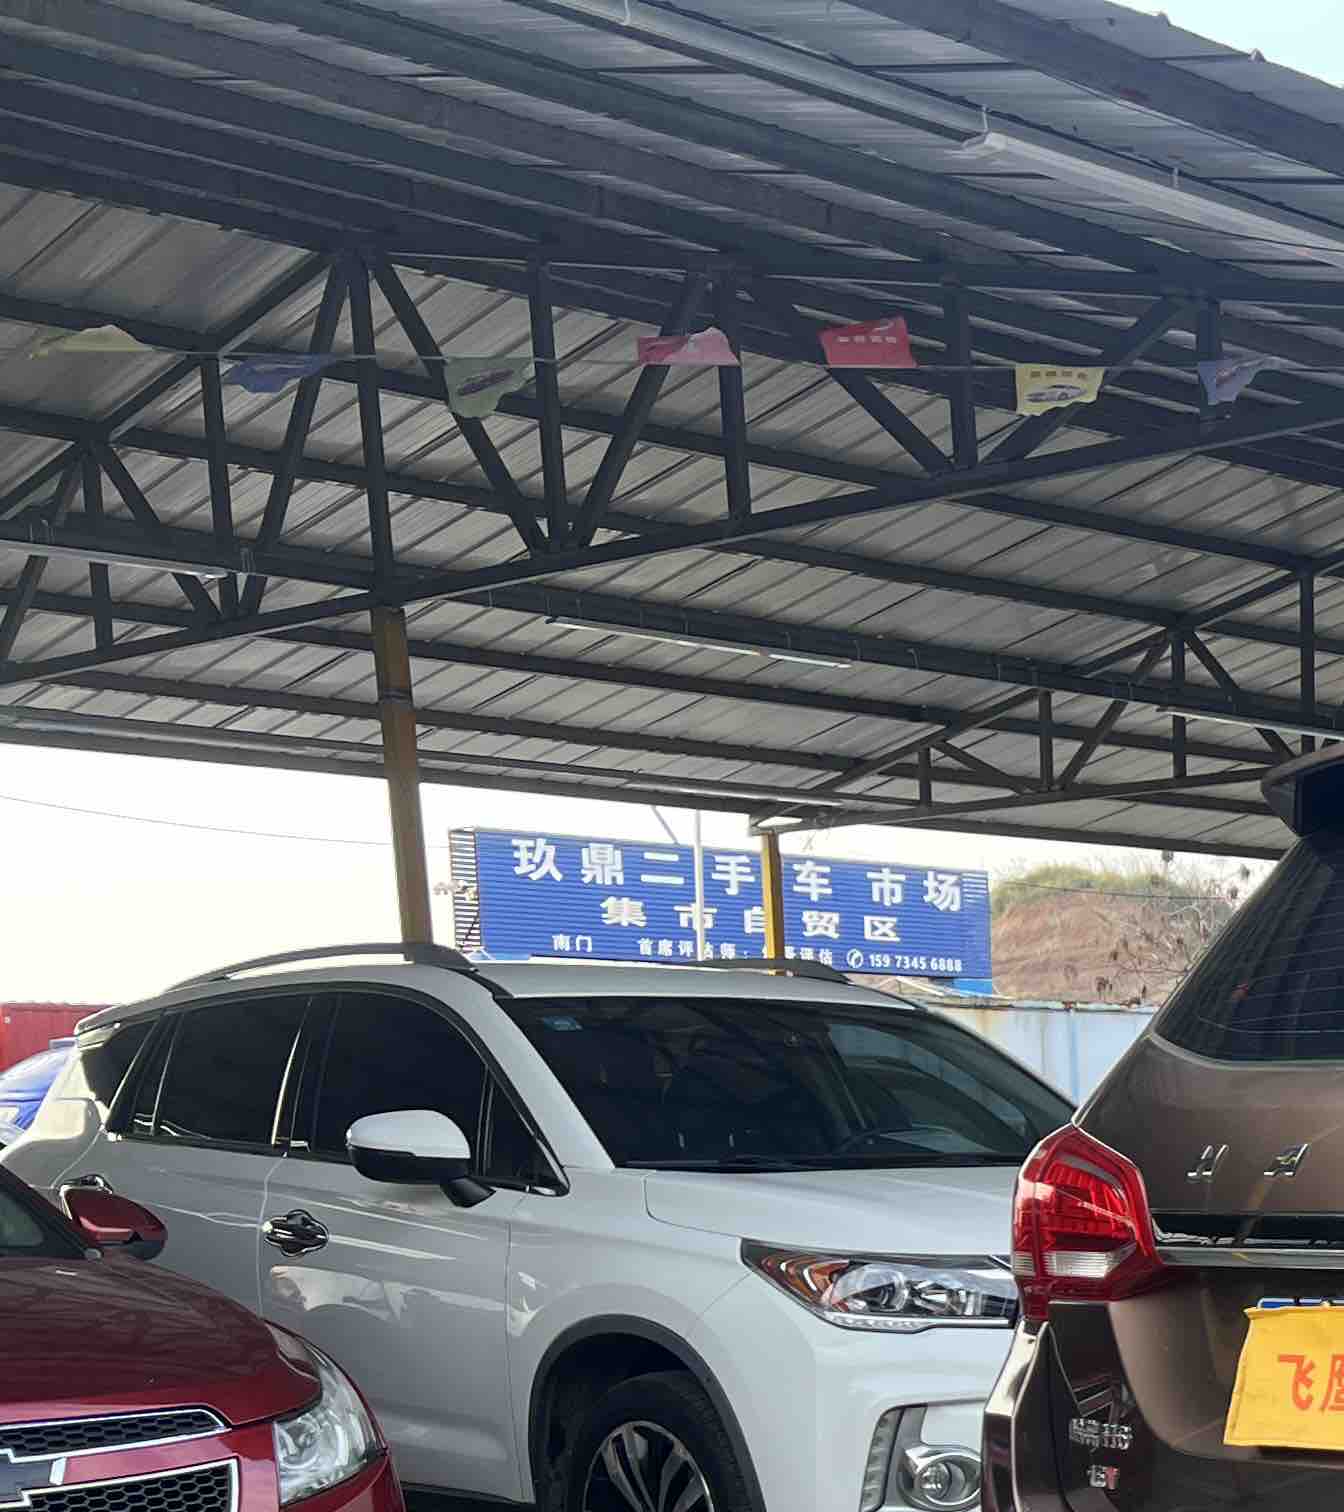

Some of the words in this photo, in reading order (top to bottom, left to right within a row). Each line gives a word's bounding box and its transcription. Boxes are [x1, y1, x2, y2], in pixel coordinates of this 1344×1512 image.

[511, 838, 961, 911] 玖鼎二手车市场
[600, 896, 900, 942] 集市自贸区
[552, 934, 593, 952] 南门
[869, 954, 890, 966] 159
[896, 956, 926, 970] 7345
